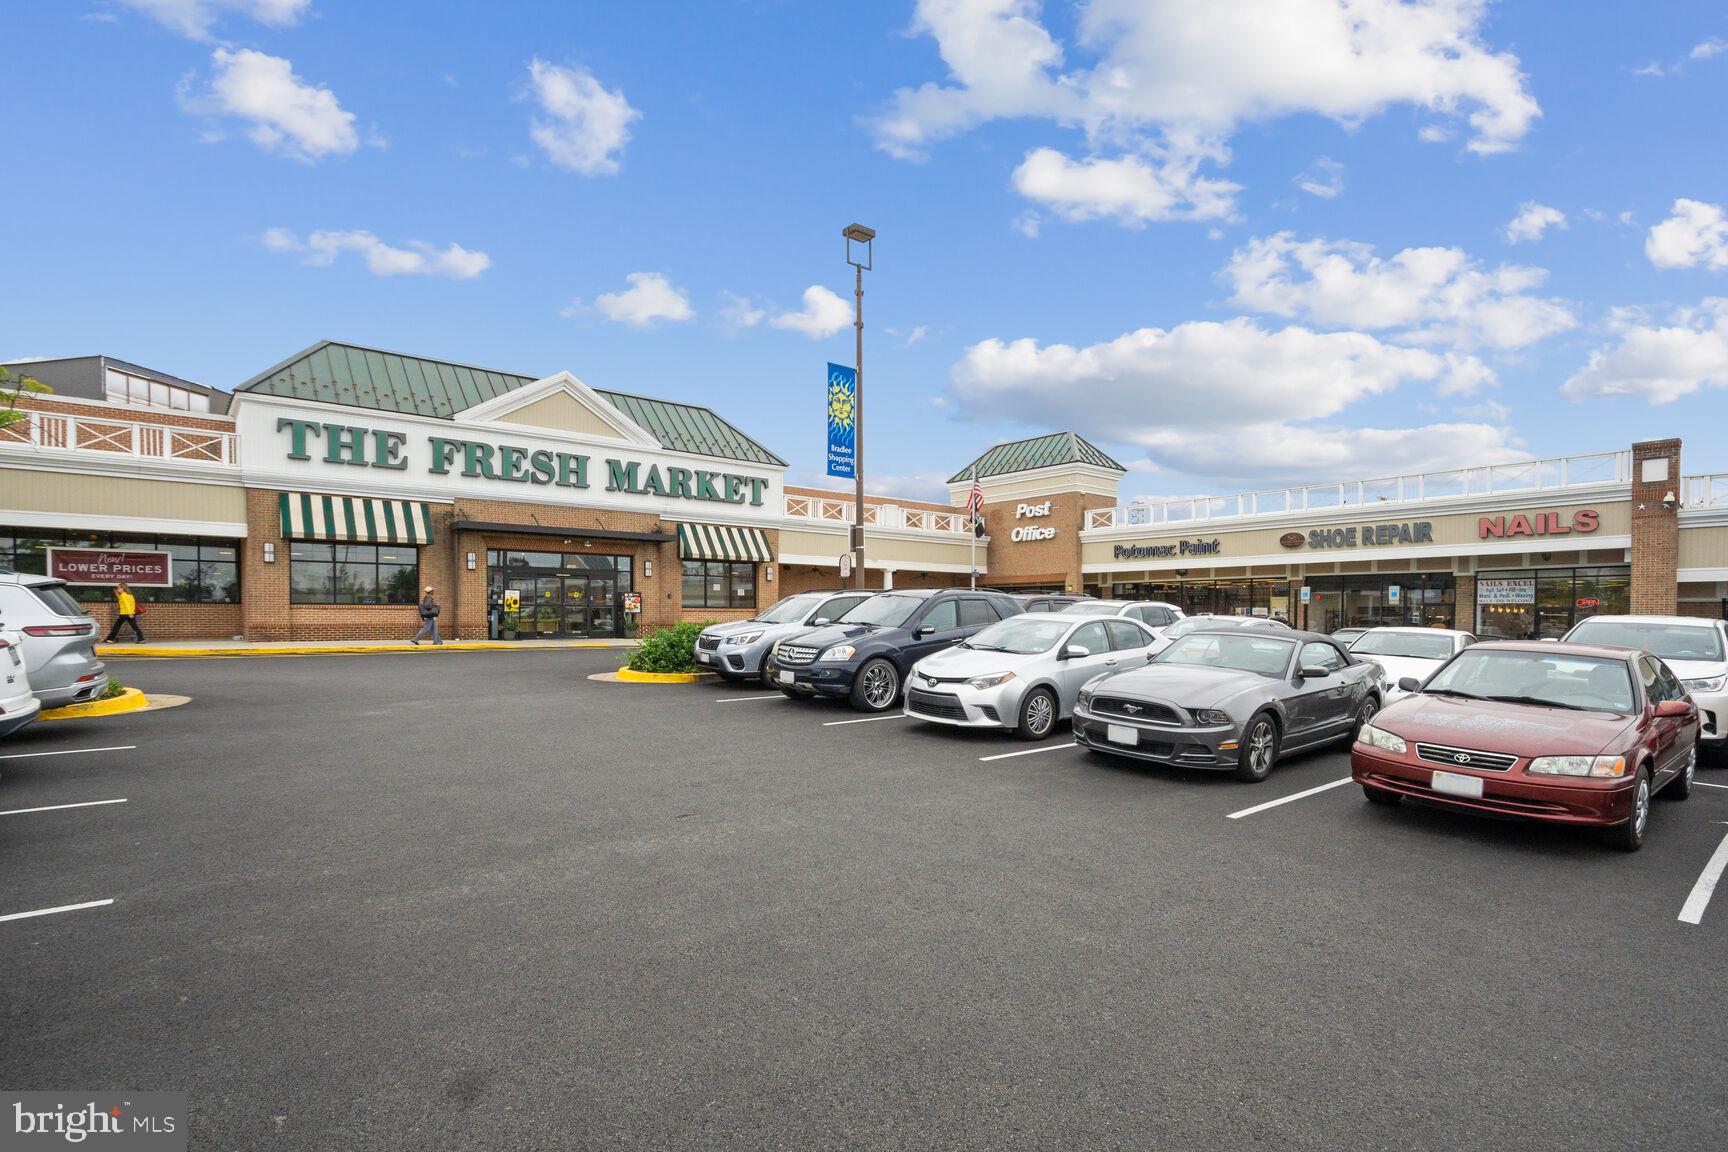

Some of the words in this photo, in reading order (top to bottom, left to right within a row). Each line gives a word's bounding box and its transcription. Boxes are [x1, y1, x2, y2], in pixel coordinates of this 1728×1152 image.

[831, 444, 852, 454] Bradlee
[277, 417, 408, 470] THE
[428, 436, 591, 488] FRESH
[605, 458, 769, 507] MARKET
[828, 453, 855, 465] Shopping
[831, 463, 851, 472] Center
[1015, 501, 1051, 519] Post
[1478, 510, 1600, 539] NAILS
[1011, 525, 1056, 542] Office
[1308, 527, 1357, 549] SHOE
[1361, 521, 1434, 546] REPAIR
[1113, 544, 1177, 559] Potomac
[1179, 538, 1221, 556] Paint
[98, 553, 125, 564] New!
[59, 563, 108, 572] LOWER
[113, 564, 162, 573] PRICES
[1575, 597, 1600, 608] OPEN
